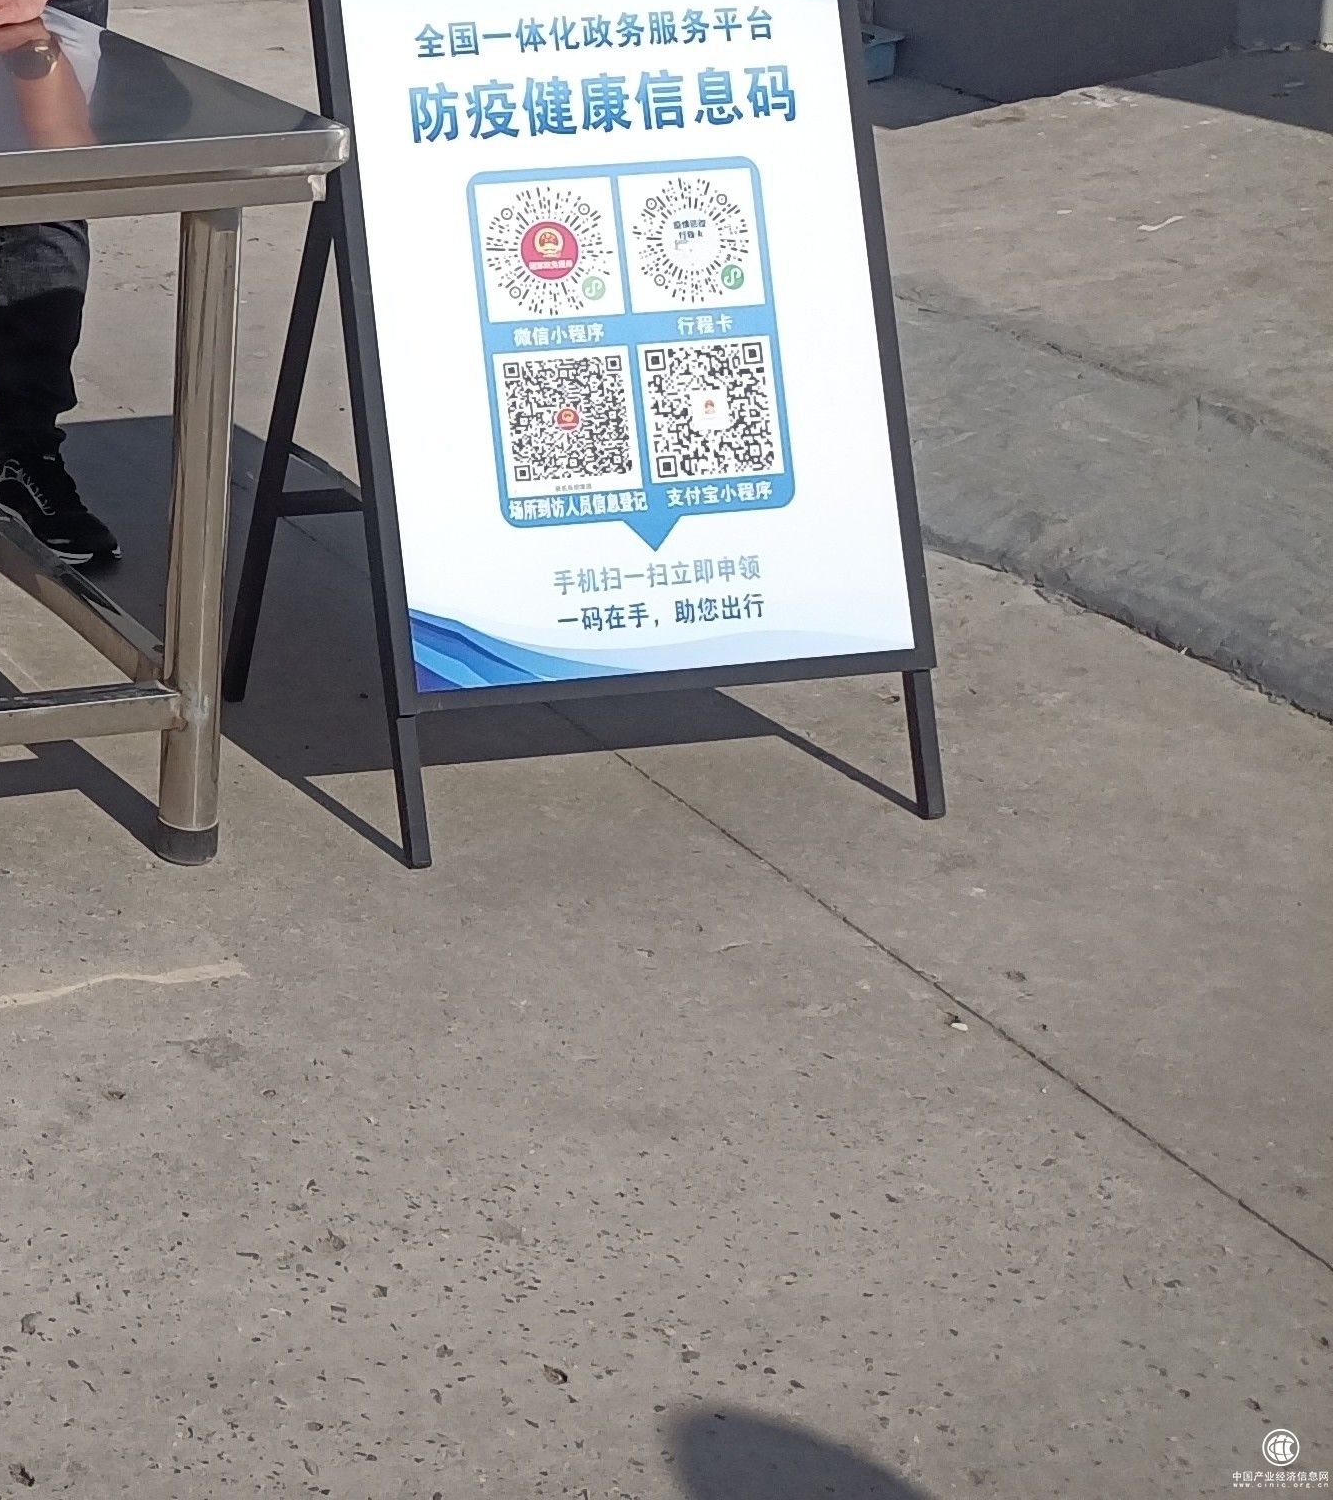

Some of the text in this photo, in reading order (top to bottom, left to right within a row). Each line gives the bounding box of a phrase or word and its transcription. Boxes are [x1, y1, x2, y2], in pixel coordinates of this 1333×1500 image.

[414, 5, 773, 59] 全国一体化政务服务平台
[408, 64, 797, 144] 防疫健康信息码
[513, 323, 605, 347] 微信小程序
[677, 313, 733, 336] 行程卡
[508, 491, 649, 521] 场所到访人员信息登记
[666, 480, 773, 508] 支付宝小程序
[553, 554, 761, 596] 手机扫一扫立即申领
[557, 592, 765, 632] 一码在手，助您出行
